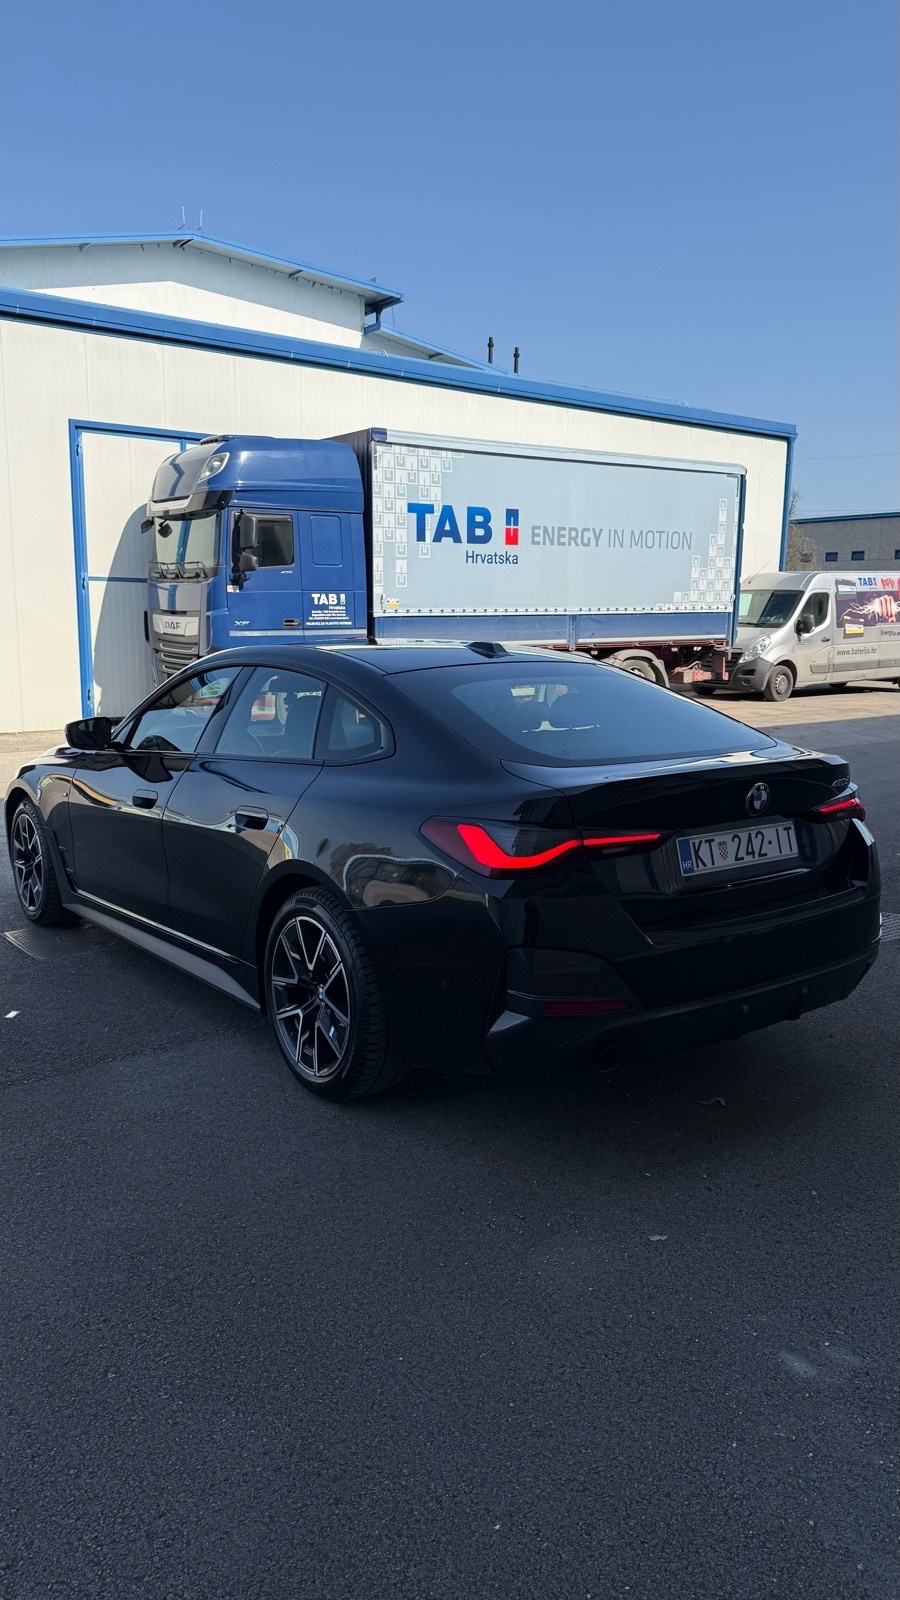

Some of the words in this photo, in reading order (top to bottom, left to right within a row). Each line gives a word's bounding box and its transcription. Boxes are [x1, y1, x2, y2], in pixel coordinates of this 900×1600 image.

[407, 502, 493, 545] TAB
[531, 525, 603, 548] ENERGY
[608, 528, 625, 549] IN
[630, 529, 692, 551] MOTION
[465, 550, 519, 565] Hrvatska
[858, 577, 873, 586] TAB
[311, 593, 338, 605] TAB
[164, 621, 182, 630] DAF
[837, 647, 877, 656] www.baterija.hr
[692, 838, 717, 869] KT
[682, 860, 693, 870] HR
